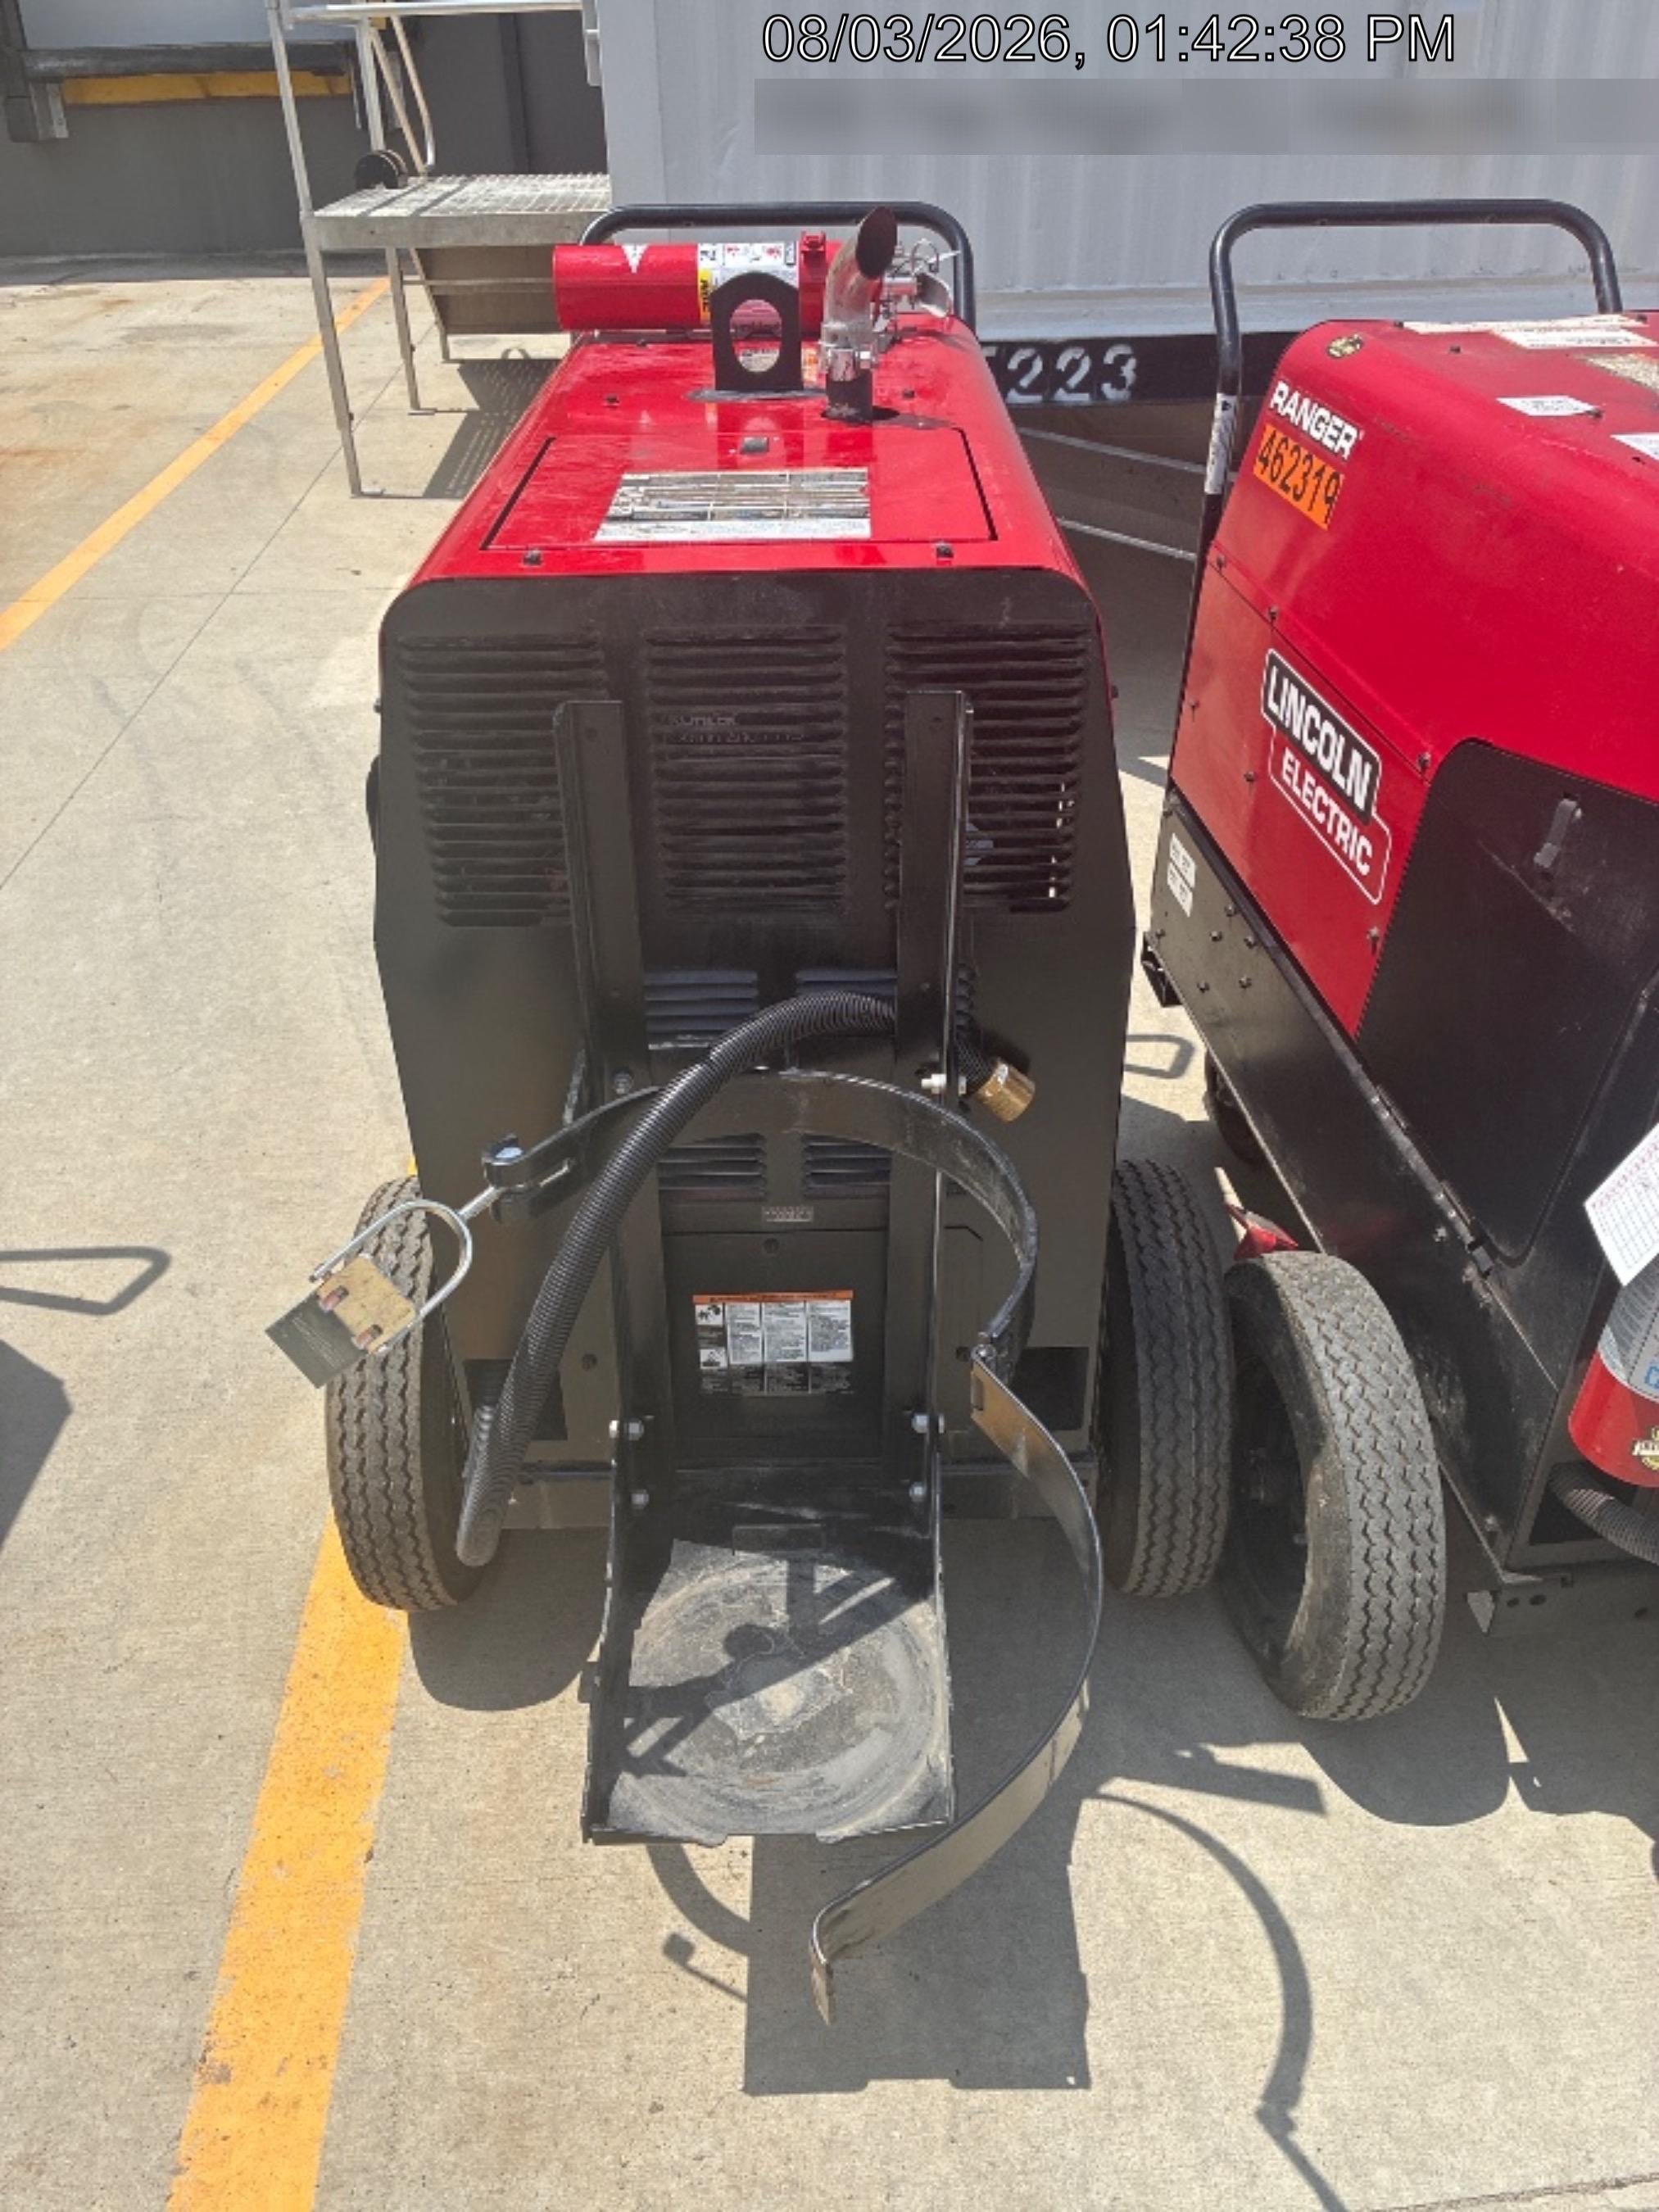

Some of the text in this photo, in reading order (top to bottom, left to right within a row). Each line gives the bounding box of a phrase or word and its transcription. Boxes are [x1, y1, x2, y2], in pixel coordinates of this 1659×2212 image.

[981, 344, 1137, 403] 223
[1271, 380, 1358, 460] RANGER
[1258, 428, 1340, 524] 462319
[1267, 665, 1372, 812] LINCOLN
[1281, 746, 1373, 877] ELECTRIC
